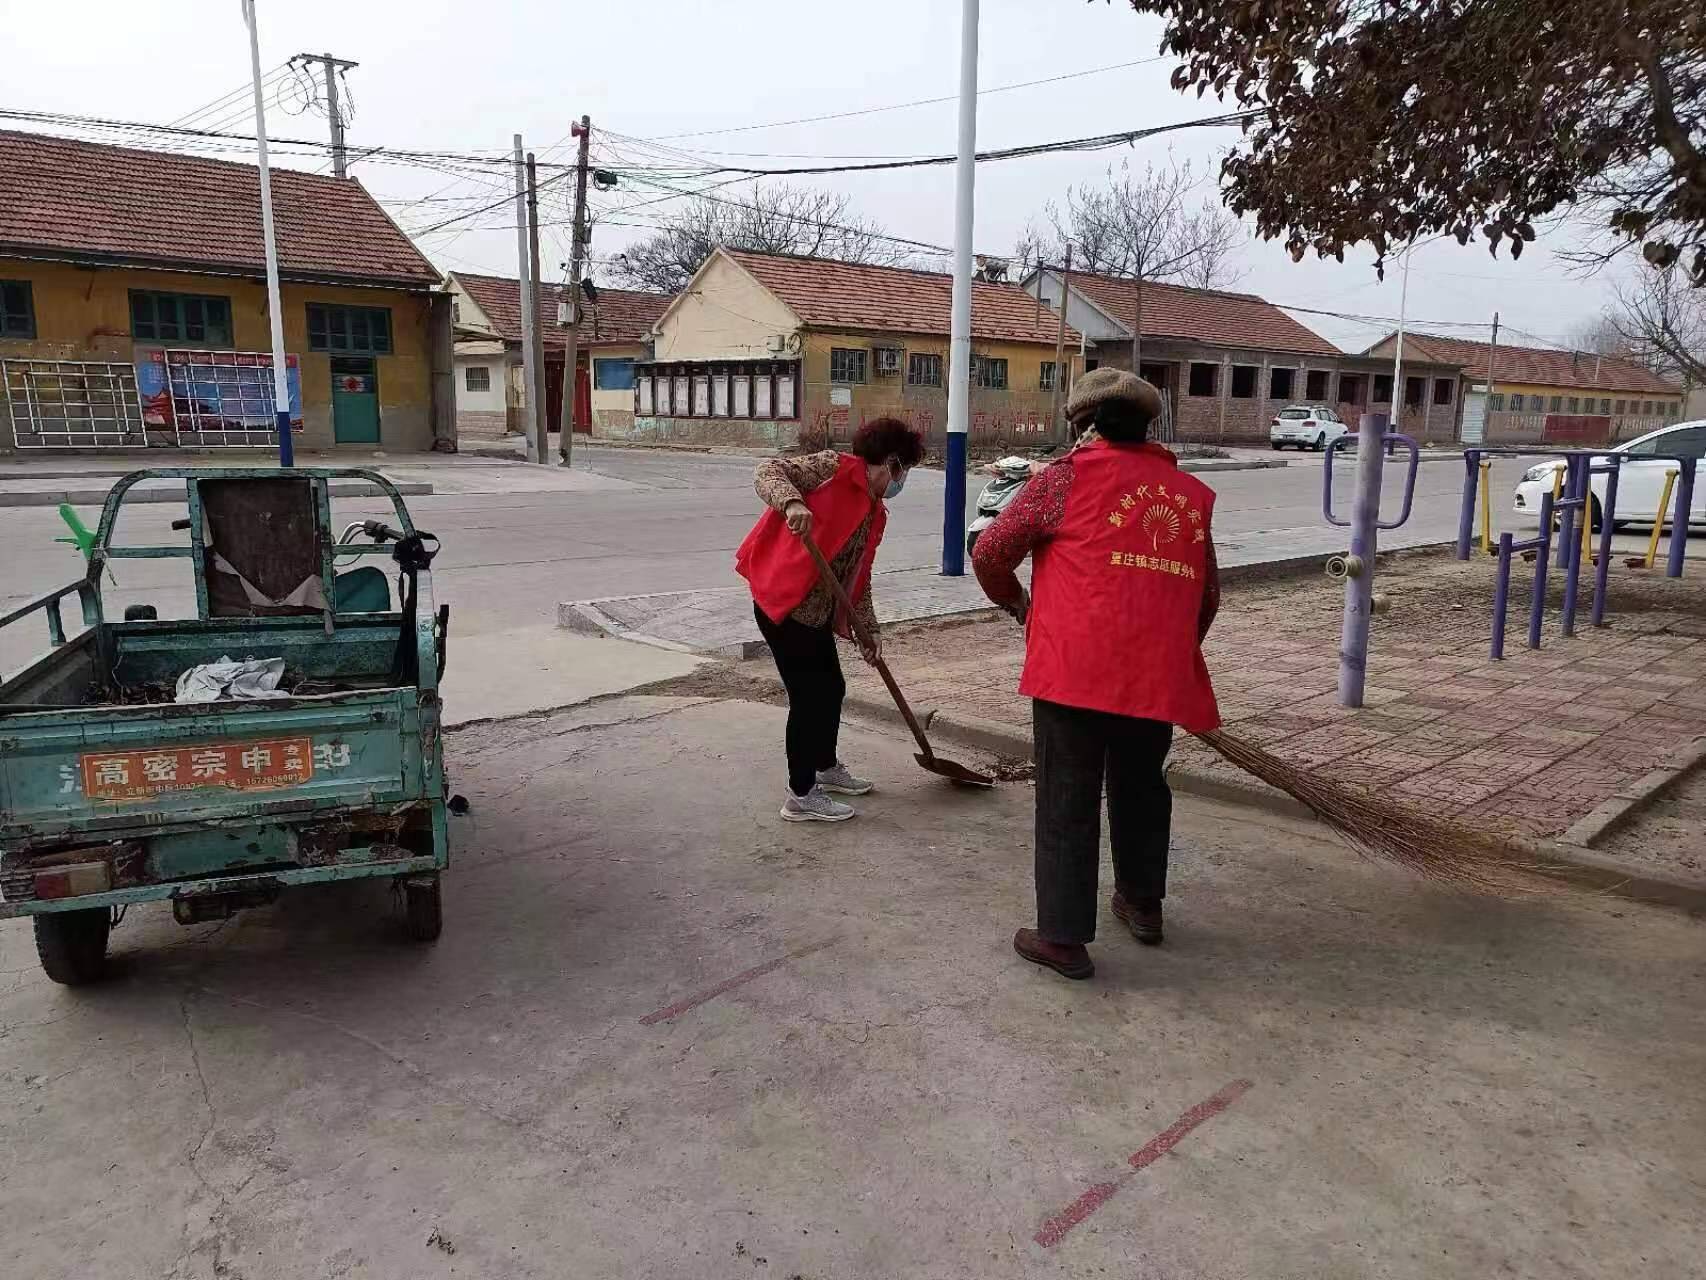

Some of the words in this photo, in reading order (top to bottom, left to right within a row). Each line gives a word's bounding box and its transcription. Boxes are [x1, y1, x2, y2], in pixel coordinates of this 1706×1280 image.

[1108, 484, 1205, 544] 新时代文明实践
[92, 747, 272, 786] 高密宗申
